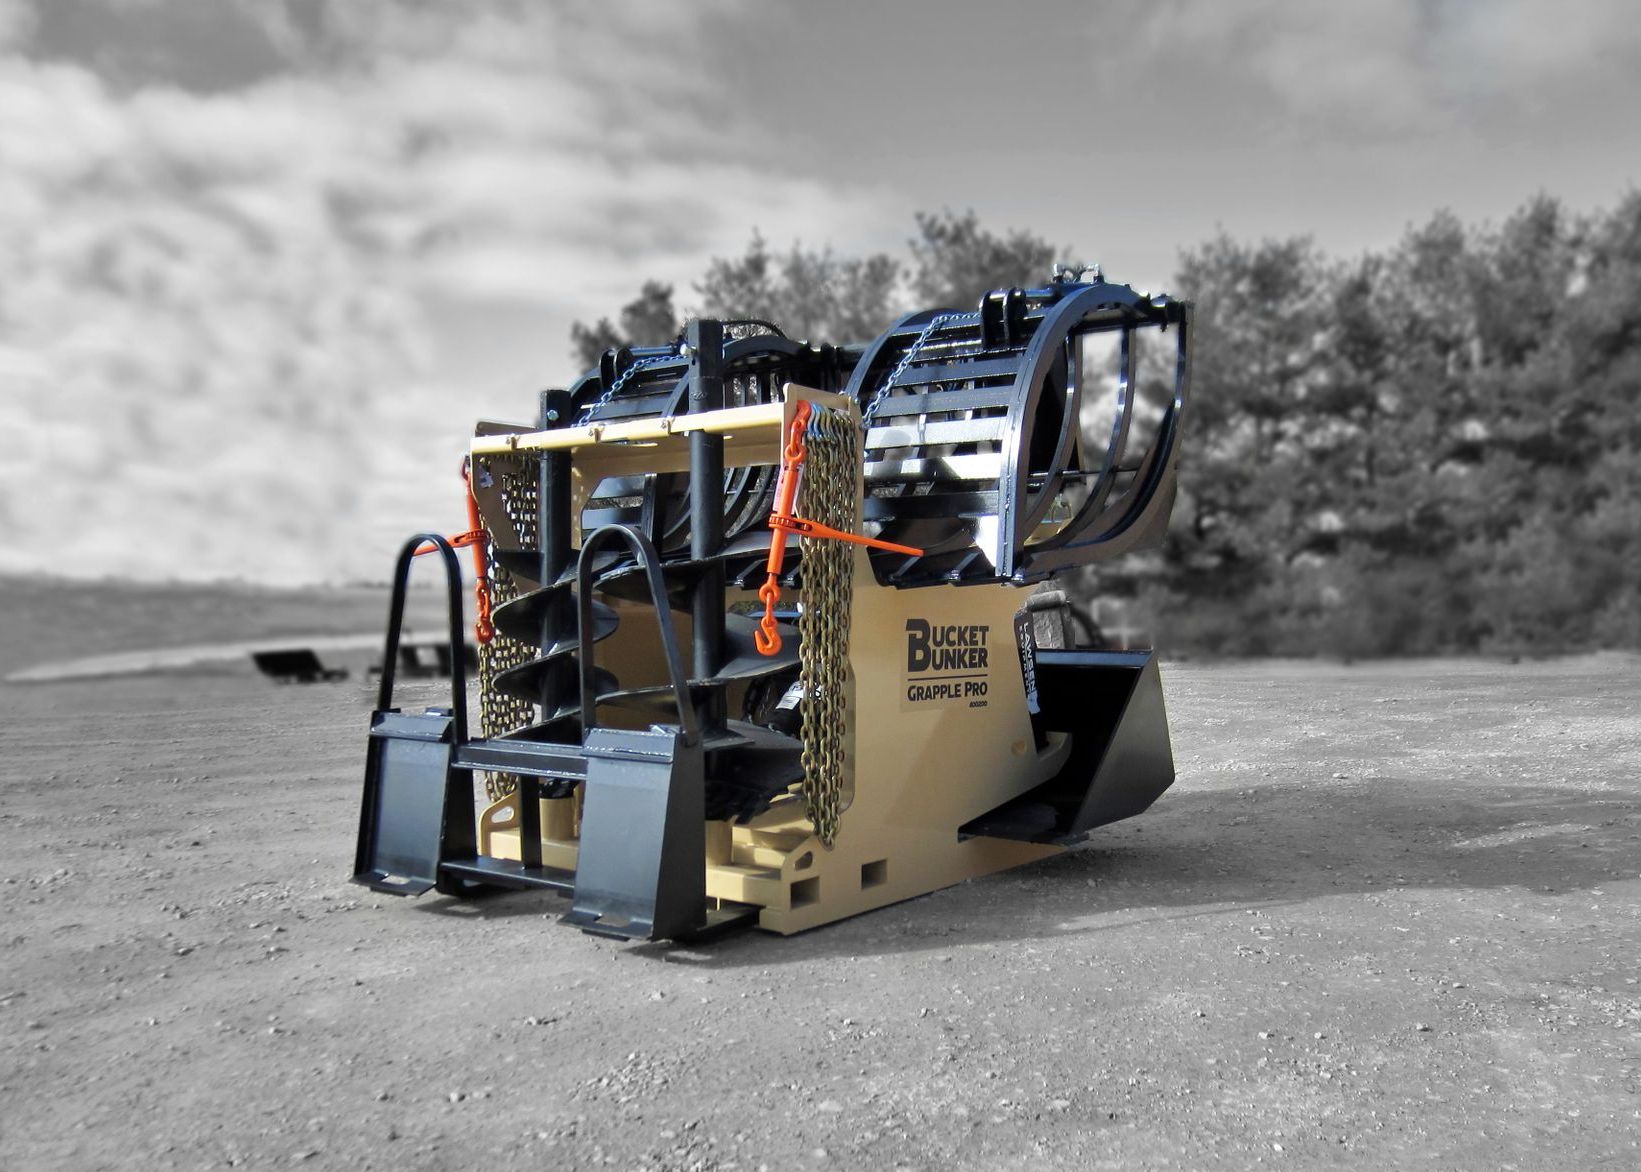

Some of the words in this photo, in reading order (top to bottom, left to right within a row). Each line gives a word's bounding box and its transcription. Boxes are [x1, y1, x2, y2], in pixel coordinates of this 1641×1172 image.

[906, 618, 989, 648] BUCKET
[907, 646, 989, 672] BUNKER
[907, 683, 961, 701] GRAPPLE
[964, 682, 988, 697] PRO
